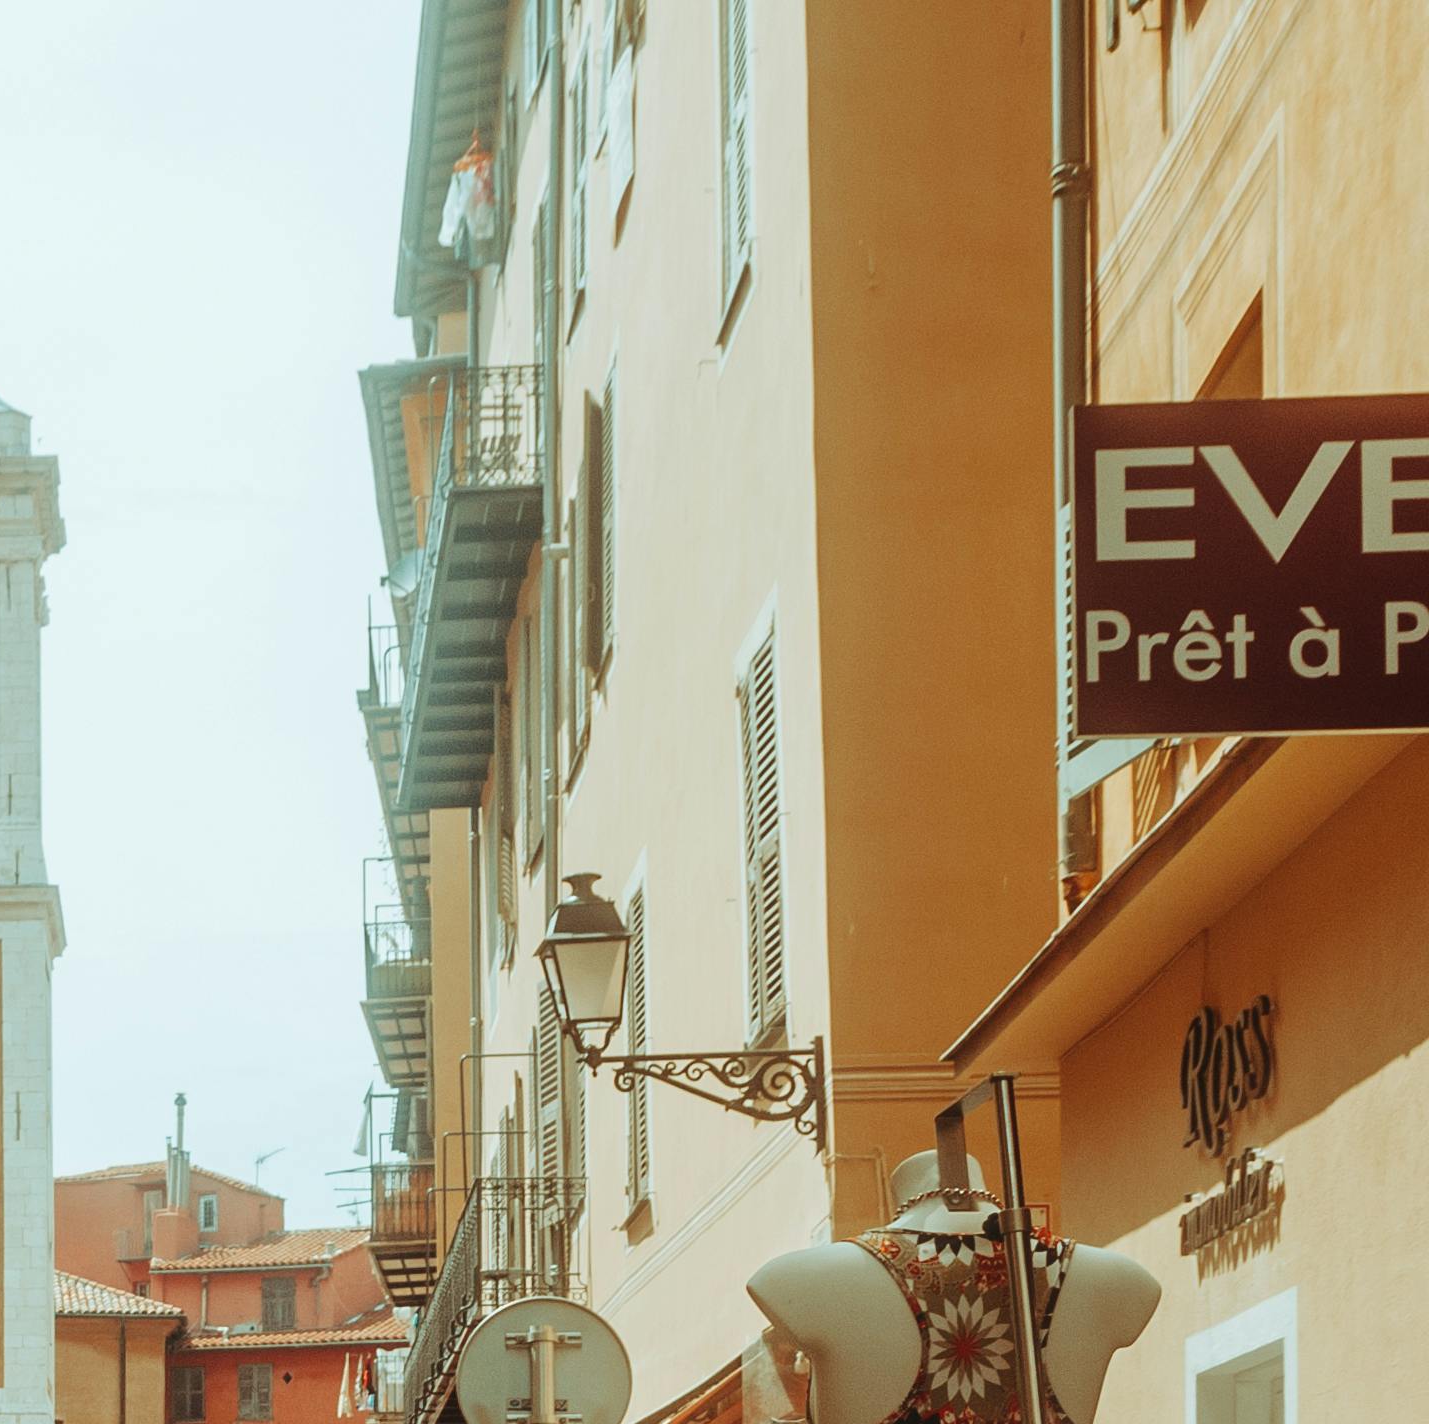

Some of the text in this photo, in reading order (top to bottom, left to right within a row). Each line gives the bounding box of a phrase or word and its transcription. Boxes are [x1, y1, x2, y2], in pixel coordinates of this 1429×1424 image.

[1095, 438, 1429, 565] EVE
[1085, 607, 1256, 683] Prêt
[1288, 605, 1341, 680] à
